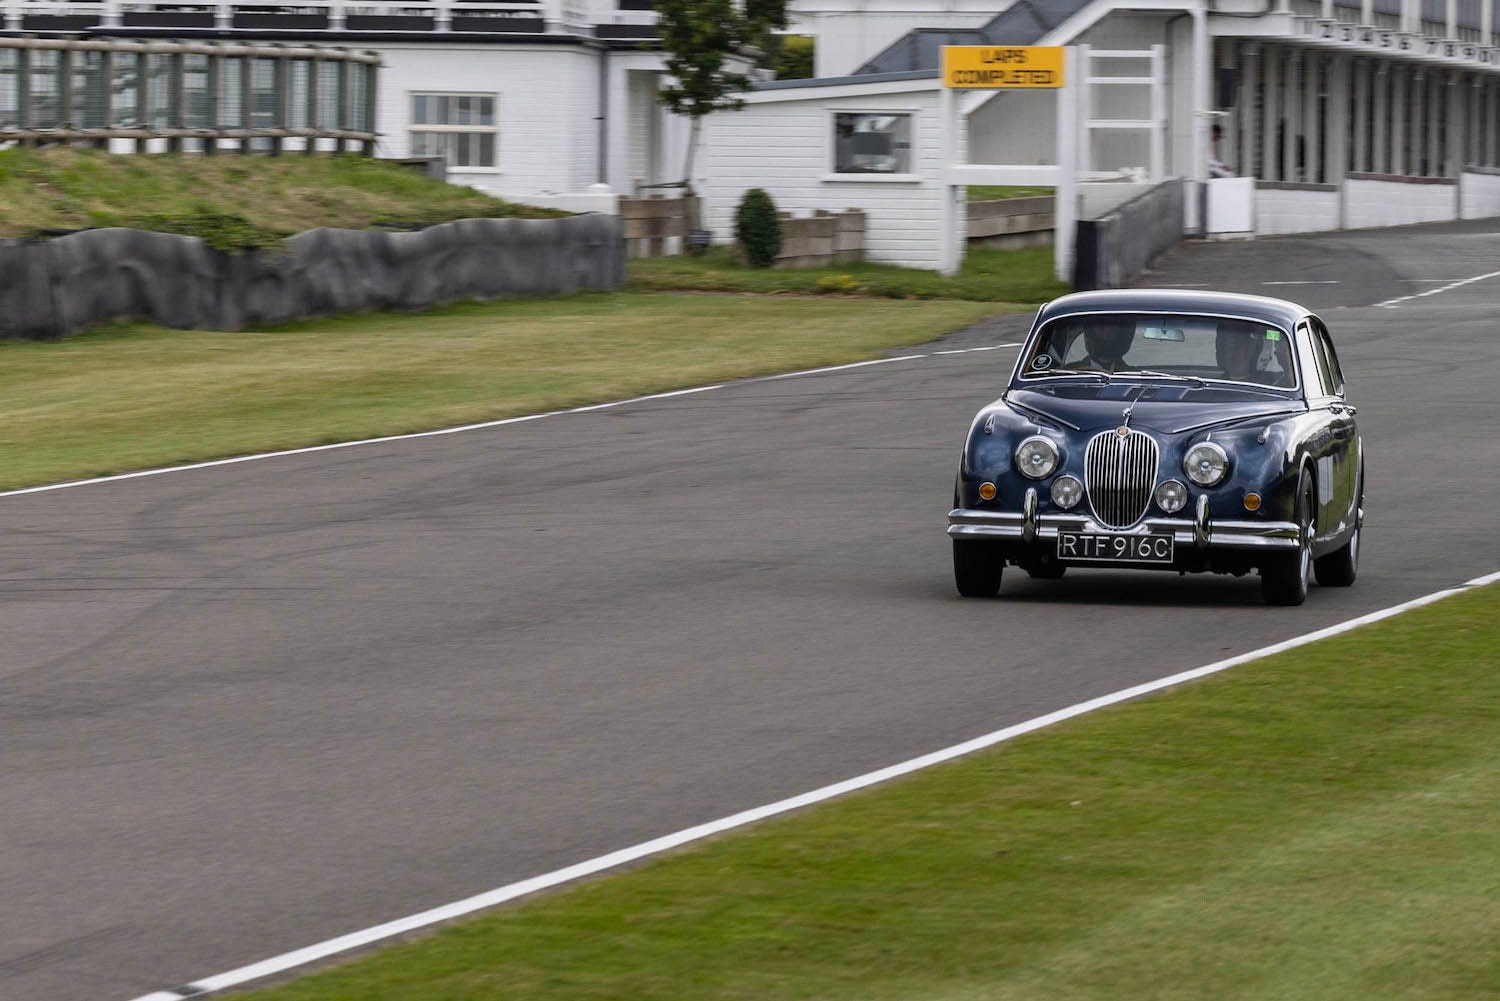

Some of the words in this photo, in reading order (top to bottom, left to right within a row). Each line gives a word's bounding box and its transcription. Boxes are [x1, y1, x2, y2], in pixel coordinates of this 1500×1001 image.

[980, 49, 1028, 63] LAPS
[952, 70, 1057, 83] COMPLETED
[1063, 534, 1168, 557] RTF916C
